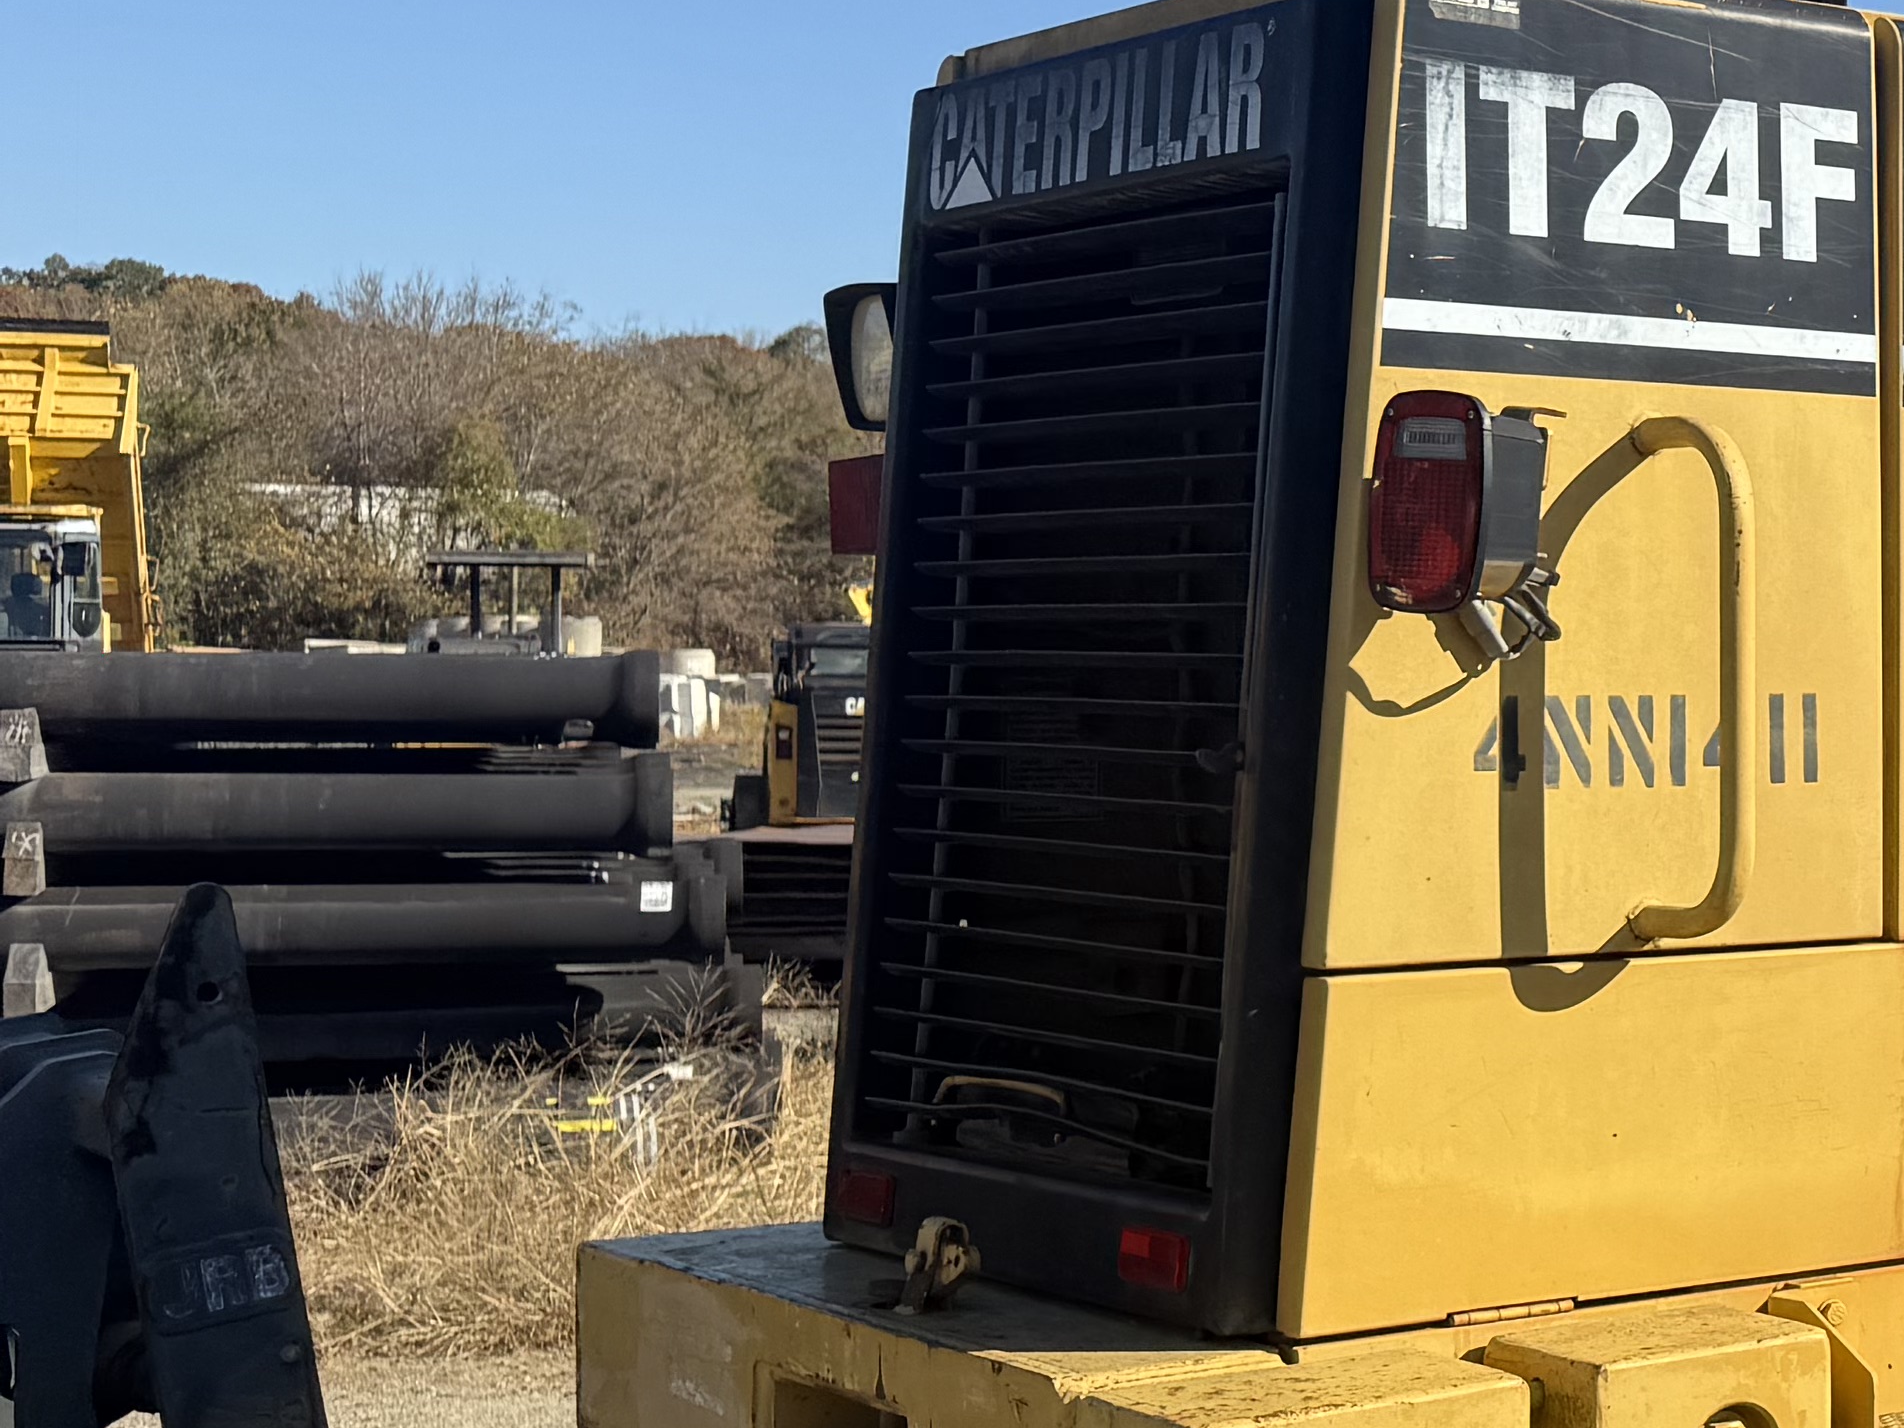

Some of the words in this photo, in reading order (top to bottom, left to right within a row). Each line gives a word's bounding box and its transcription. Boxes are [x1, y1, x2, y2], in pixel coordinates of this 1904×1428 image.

[929, 21, 1266, 211] CATERPILLAR
[1425, 58, 1858, 262] IT24F
[845, 696, 865, 717] CA
